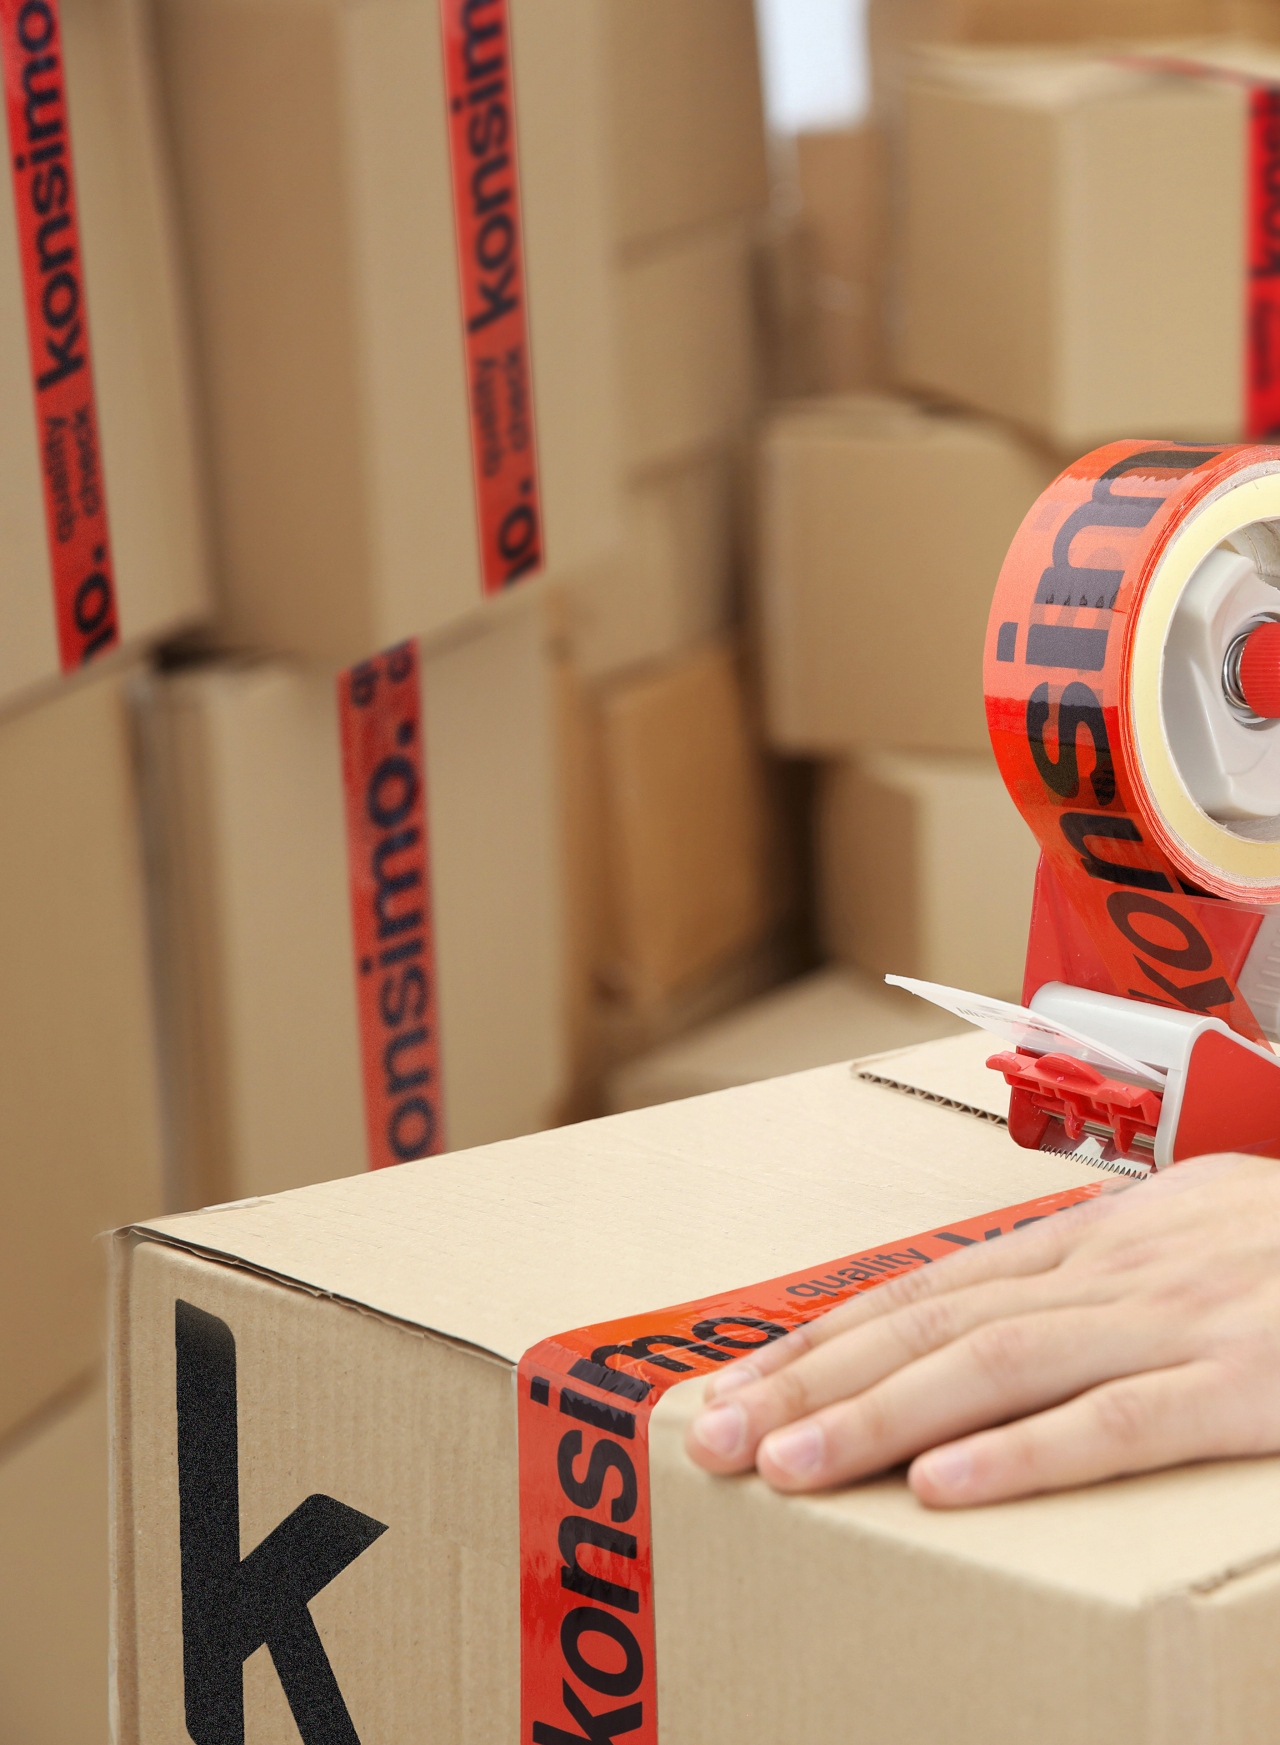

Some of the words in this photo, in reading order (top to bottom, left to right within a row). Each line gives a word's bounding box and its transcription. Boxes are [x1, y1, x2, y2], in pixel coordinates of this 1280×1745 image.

[996, 441, 1235, 1014] konsim
[786, 1244, 934, 1299] quality
[530, 1315, 804, 1745] konsimo
